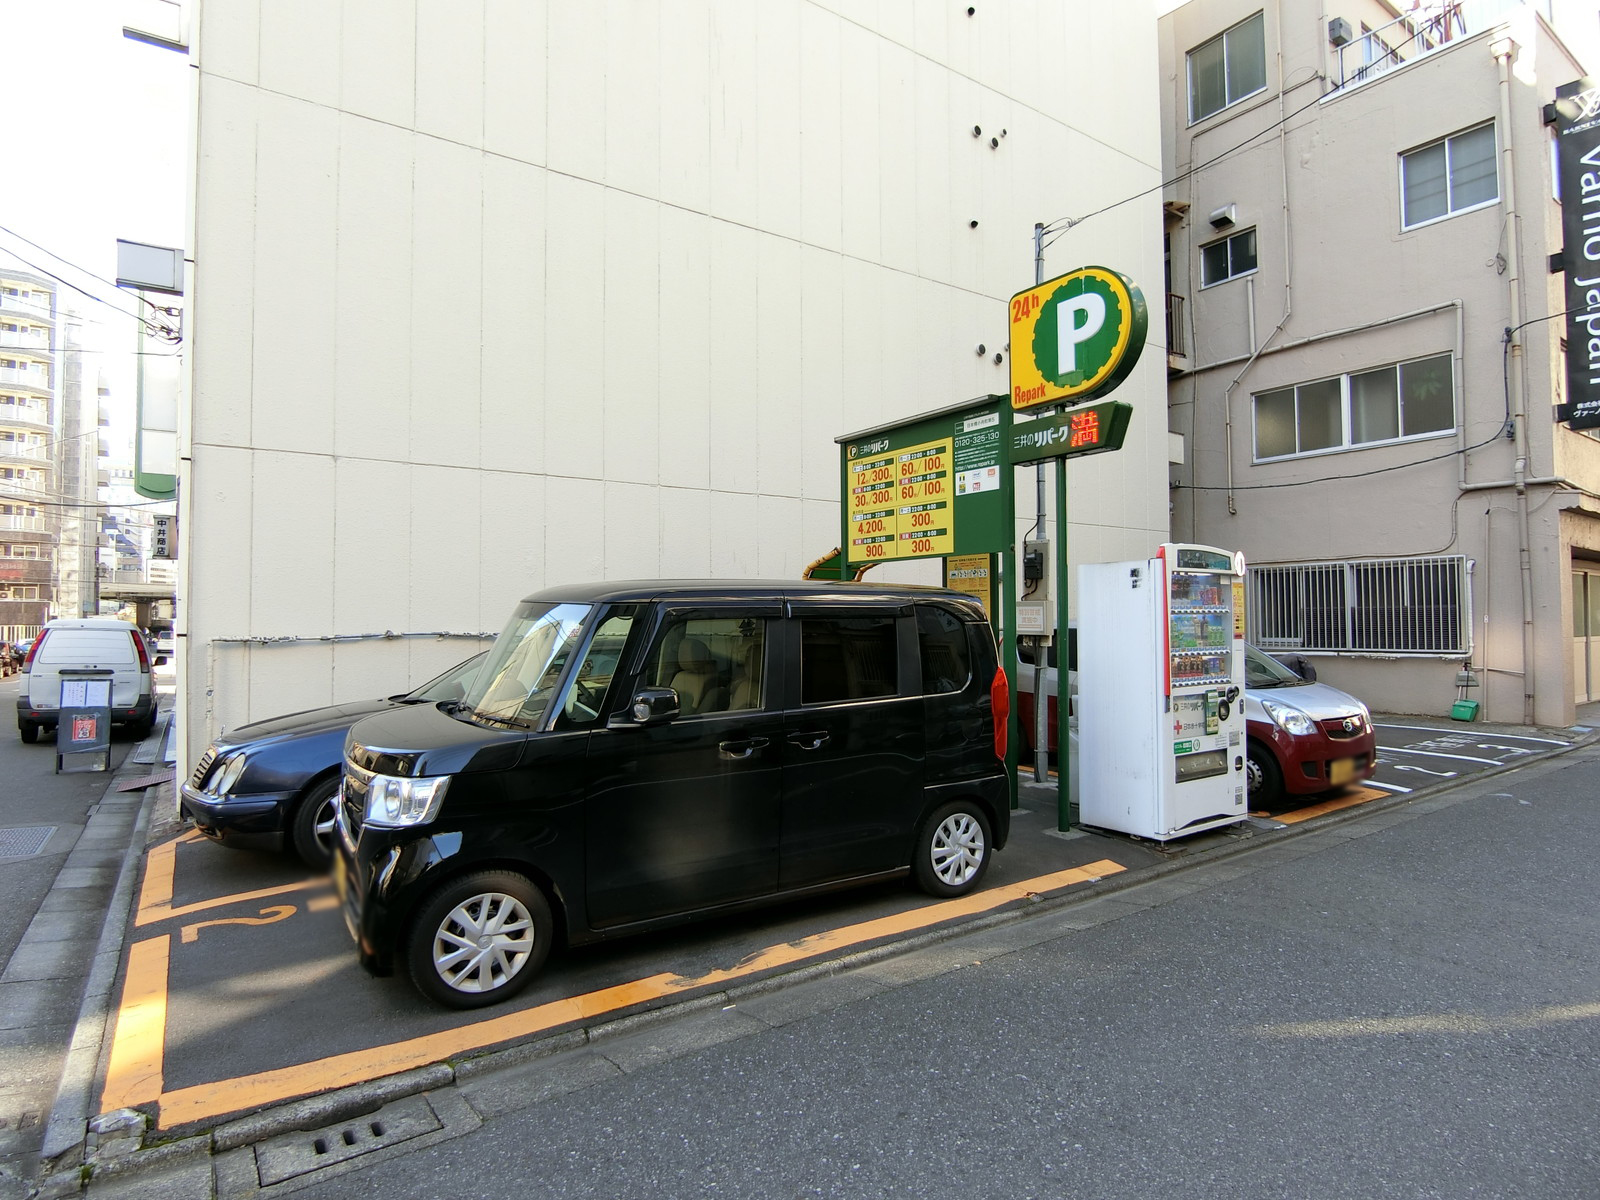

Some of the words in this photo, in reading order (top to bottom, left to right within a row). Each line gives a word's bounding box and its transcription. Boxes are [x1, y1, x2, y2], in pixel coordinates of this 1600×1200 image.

[1013, 293, 1040, 324] 24h
[1057, 292, 1106, 376] P
[1014, 383, 1046, 404] Repark
[1013, 425, 1069, 449] 三井のリパーク
[1070, 410, 1099, 447] 満
